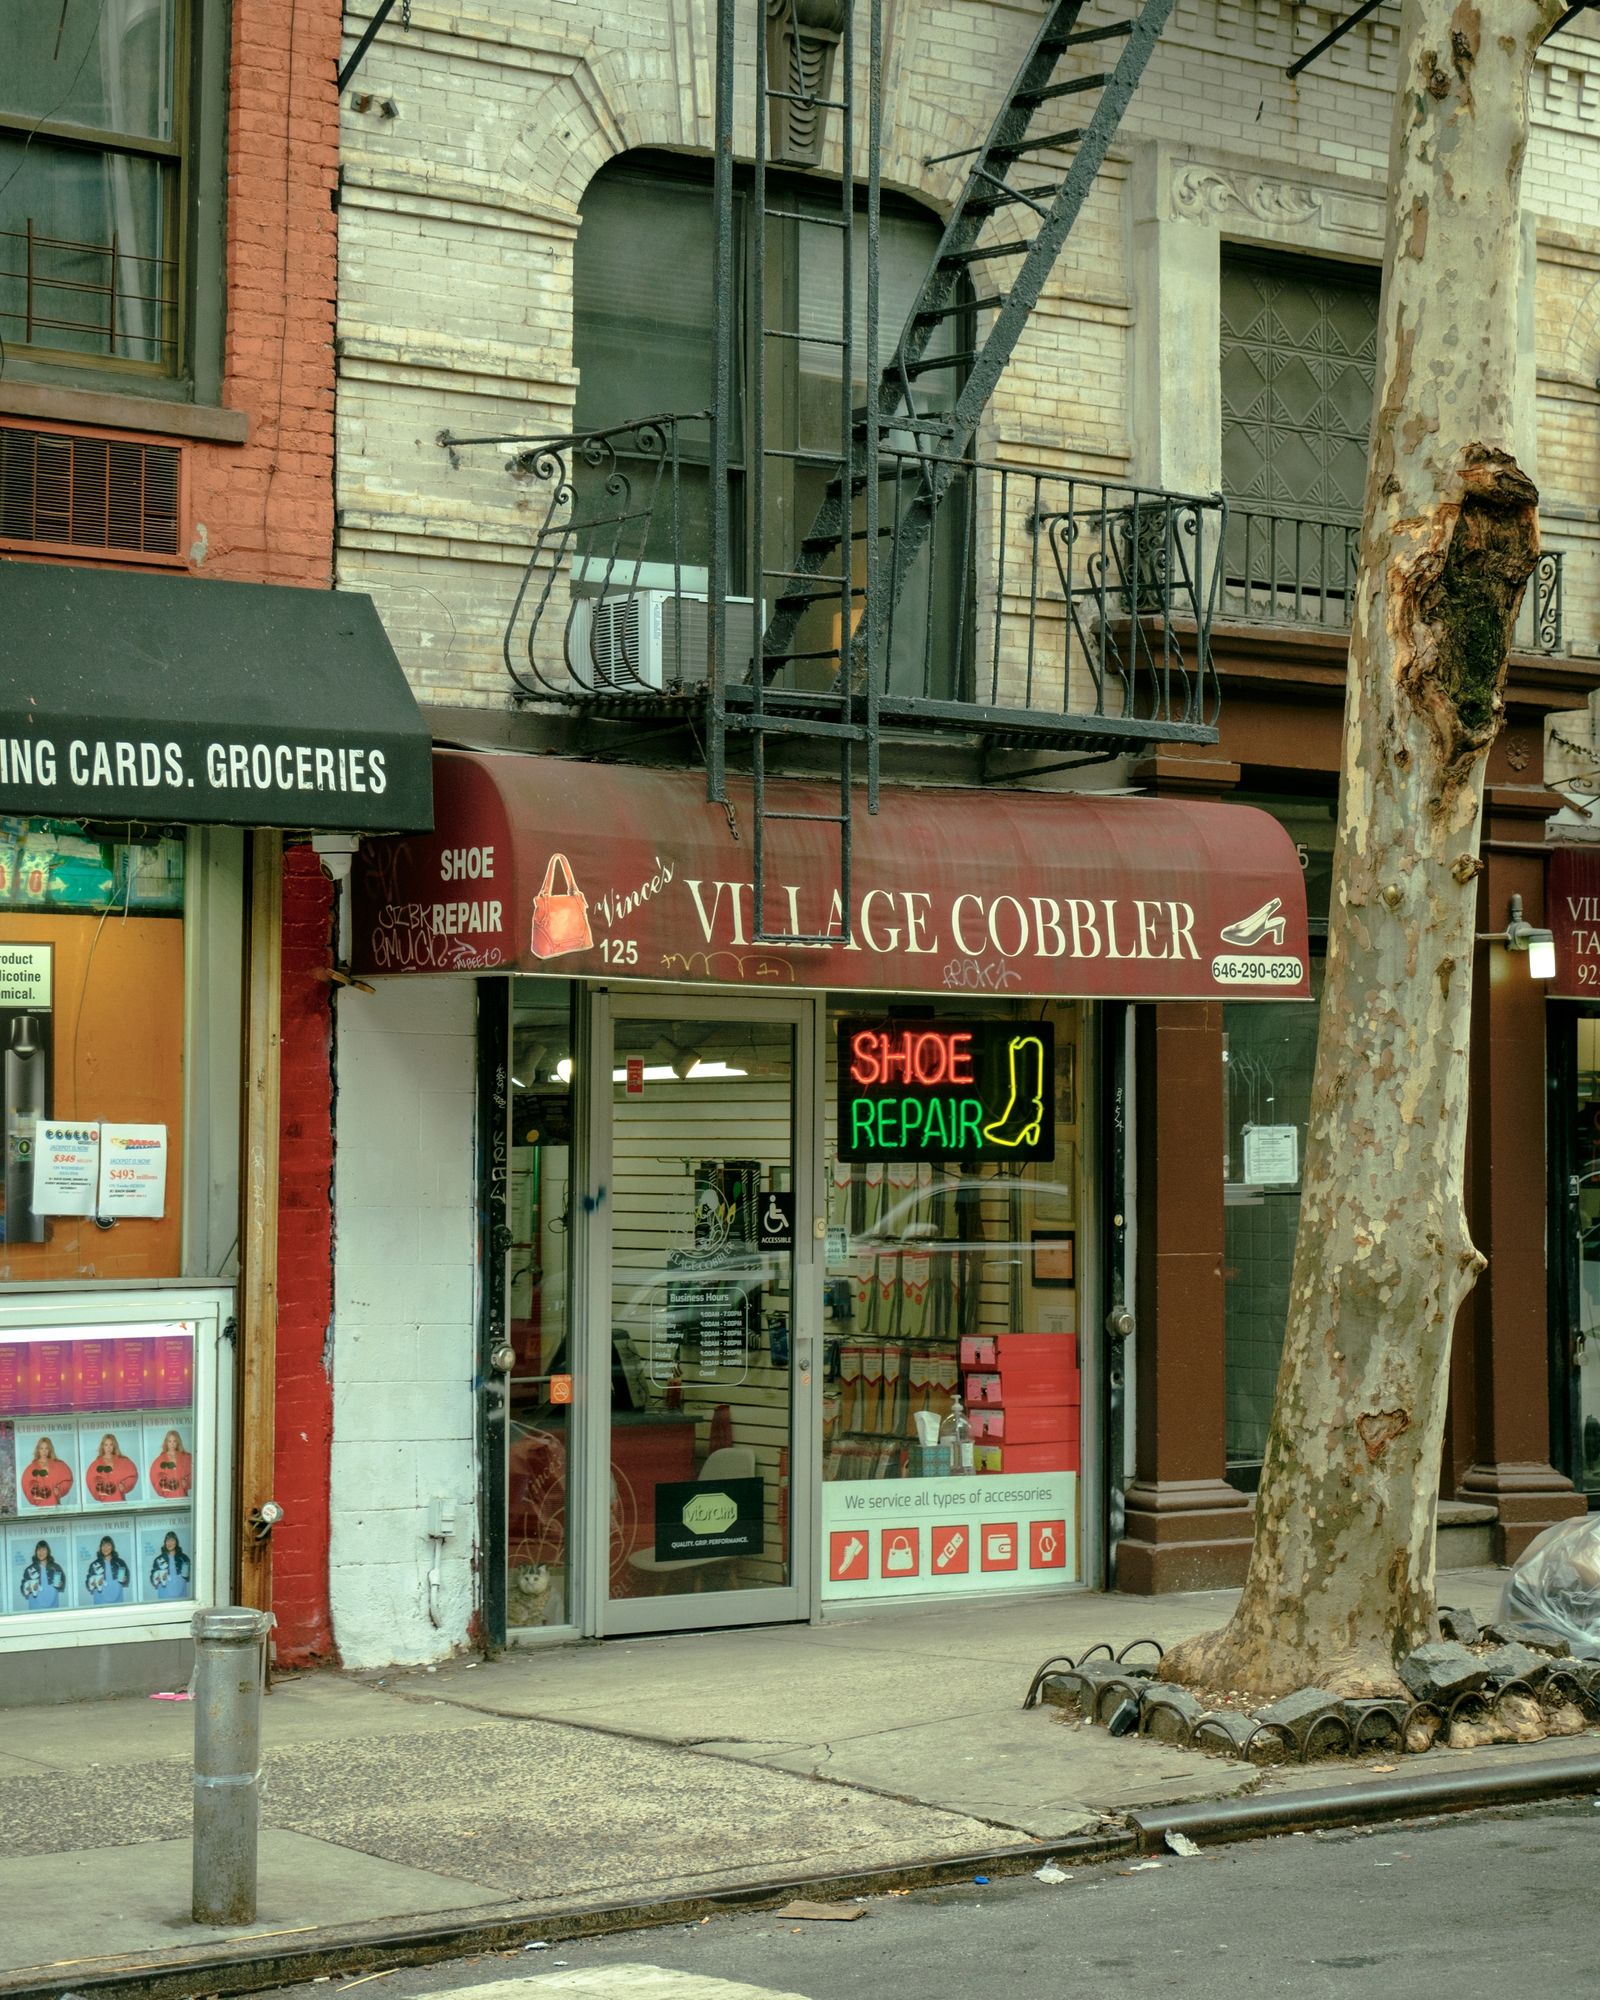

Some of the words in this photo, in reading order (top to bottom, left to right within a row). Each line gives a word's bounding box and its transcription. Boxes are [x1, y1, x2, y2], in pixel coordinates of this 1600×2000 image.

[0, 739, 57, 787] ING
[69, 739, 195, 788] CARDS.
[206, 743, 388, 794] GROCERIES
[440, 846, 494, 881] SHOE
[594, 856, 675, 928] Vince's
[432, 900, 503, 935] REPAIR
[951, 893, 1202, 960] COBBLER
[0, 952, 33, 965] oduct
[598, 939, 639, 965] 125
[1212, 961, 1302, 981] 646-290-6230
[1577, 964, 1600, 985] 92
[850, 1031, 975, 1085] SHOE
[850, 1097, 984, 1150] REPAIR
[110, 1169, 135, 1180] $493
[761, 1236, 792, 1244] ACCESSIBLE
[698, 1240, 735, 1271] COBBLER
[670, 1293, 705, 1303] Business
[705, 1292, 729, 1302] Hours
[846, 1495, 865, 1509] We
[868, 1492, 911, 1508] service
[914, 1491, 930, 1506] all
[933, 1491, 966, 1508] types
[969, 1488, 983, 1504] of
[985, 1486, 1052, 1503] accessories
[686, 1504, 736, 1523] vibram
[671, 1540, 694, 1549] QUALITY.
[709, 1536, 749, 1545] PERFORMANCE.
